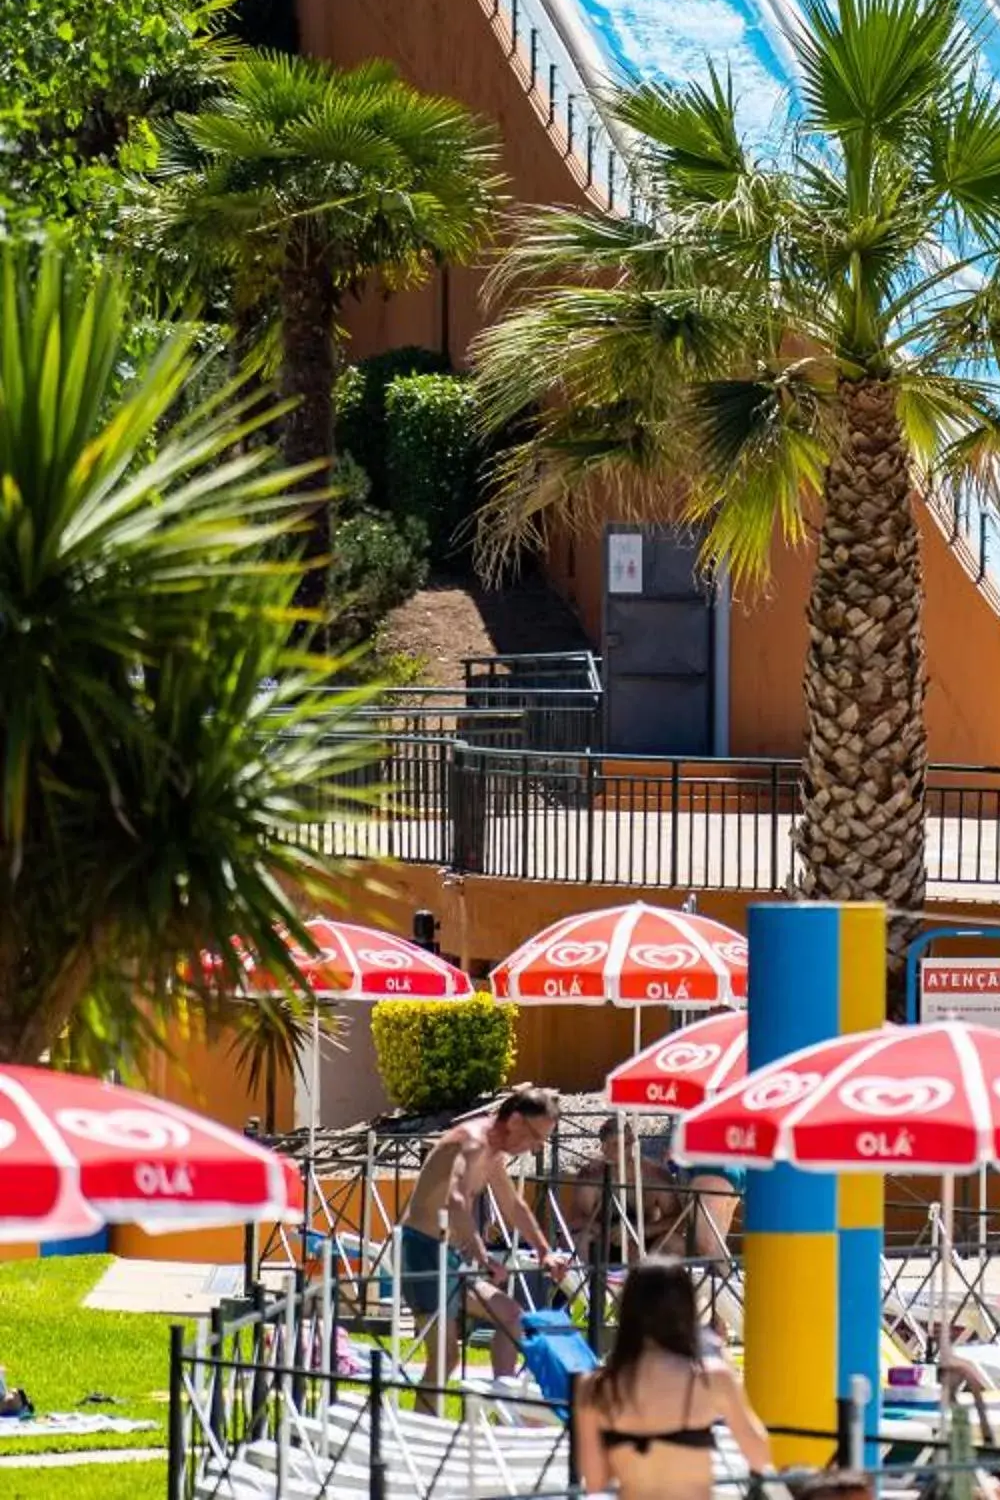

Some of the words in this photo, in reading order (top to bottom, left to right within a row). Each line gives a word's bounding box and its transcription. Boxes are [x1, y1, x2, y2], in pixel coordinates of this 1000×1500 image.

[385, 975, 411, 991] OLÁ
[543, 974, 583, 997] OLÁ
[645, 977, 689, 999] OLÁ
[646, 1082, 678, 1101] OLÁ
[855, 1127, 913, 1157] OLÁ
[133, 1160, 194, 1197] OLÁ
